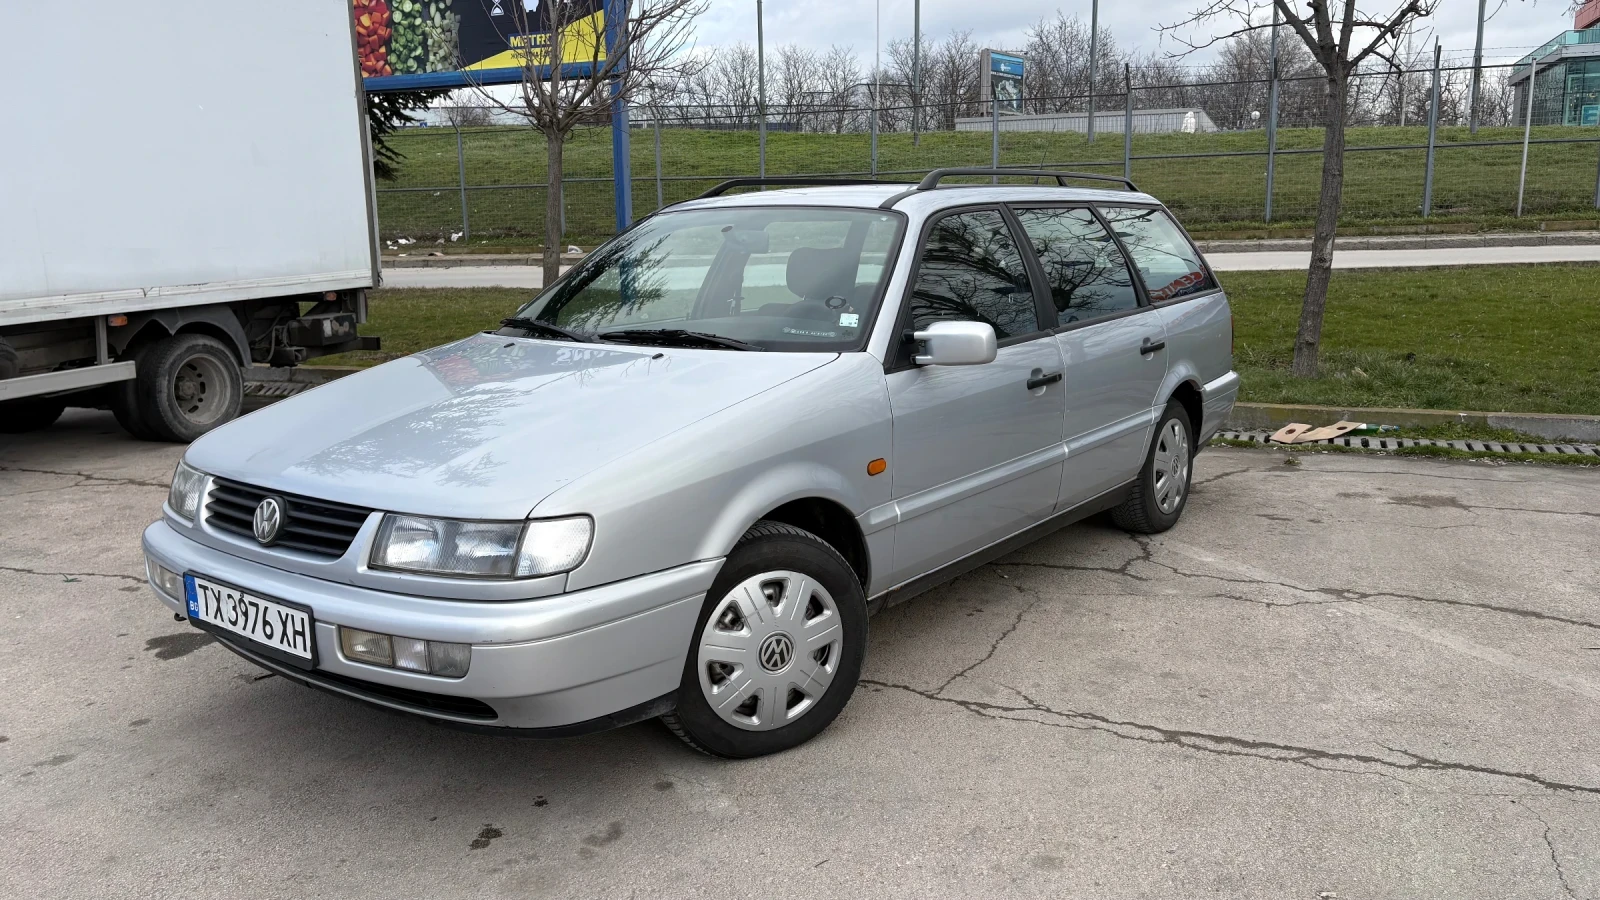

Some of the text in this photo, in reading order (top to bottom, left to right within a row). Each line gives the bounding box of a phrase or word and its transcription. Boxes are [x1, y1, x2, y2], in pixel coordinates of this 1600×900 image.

[189, 600, 199, 612] BG
[197, 583, 308, 652] TX 3976 XH
